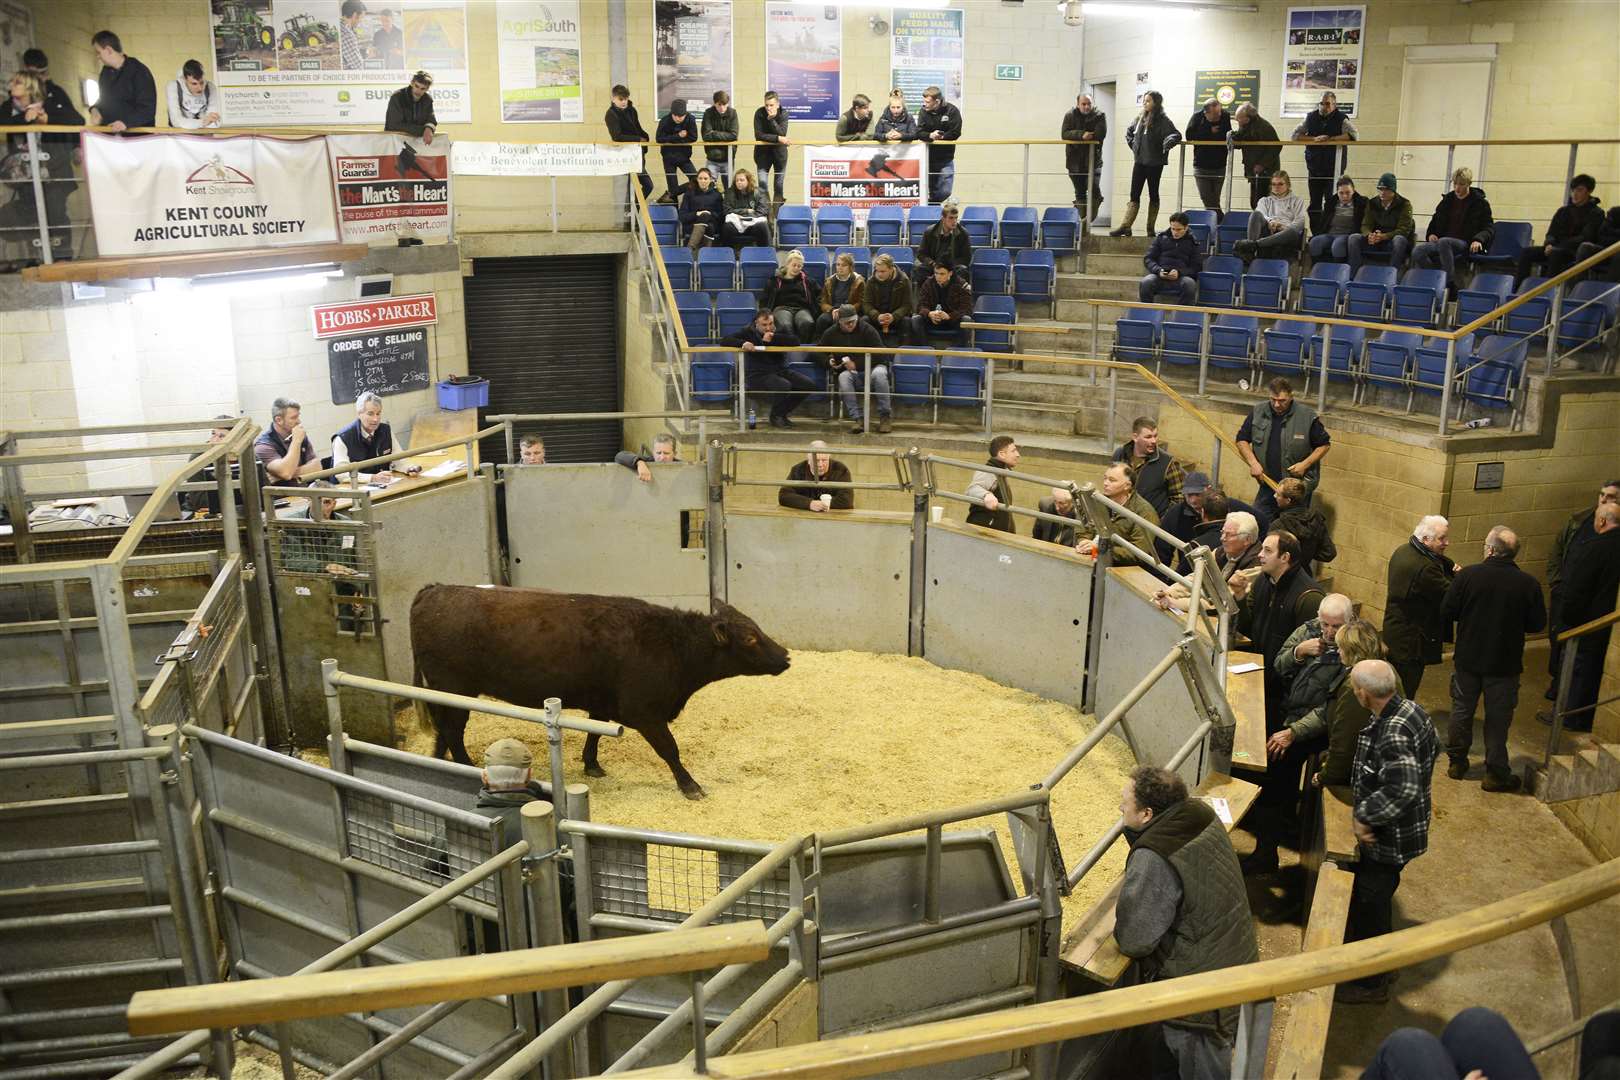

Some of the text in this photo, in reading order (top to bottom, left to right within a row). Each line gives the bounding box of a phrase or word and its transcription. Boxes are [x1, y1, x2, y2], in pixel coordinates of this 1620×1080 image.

[498, 144, 597, 156] Royal Agricultural
[341, 160, 376, 170] Farmers
[491, 155, 604, 166] Benevolent Institution
[341, 169, 377, 178] Guardian
[186, 186, 206, 195] Kent
[165, 205, 268, 222] KENT COUNTY
[355, 210, 375, 220] pulse
[376, 208, 385, 217] of
[386, 208, 398, 216] the
[134, 220, 306, 242] AGRICULTURAL SOCIETY
[333, 331, 423, 353] ORDER OF SELLING
